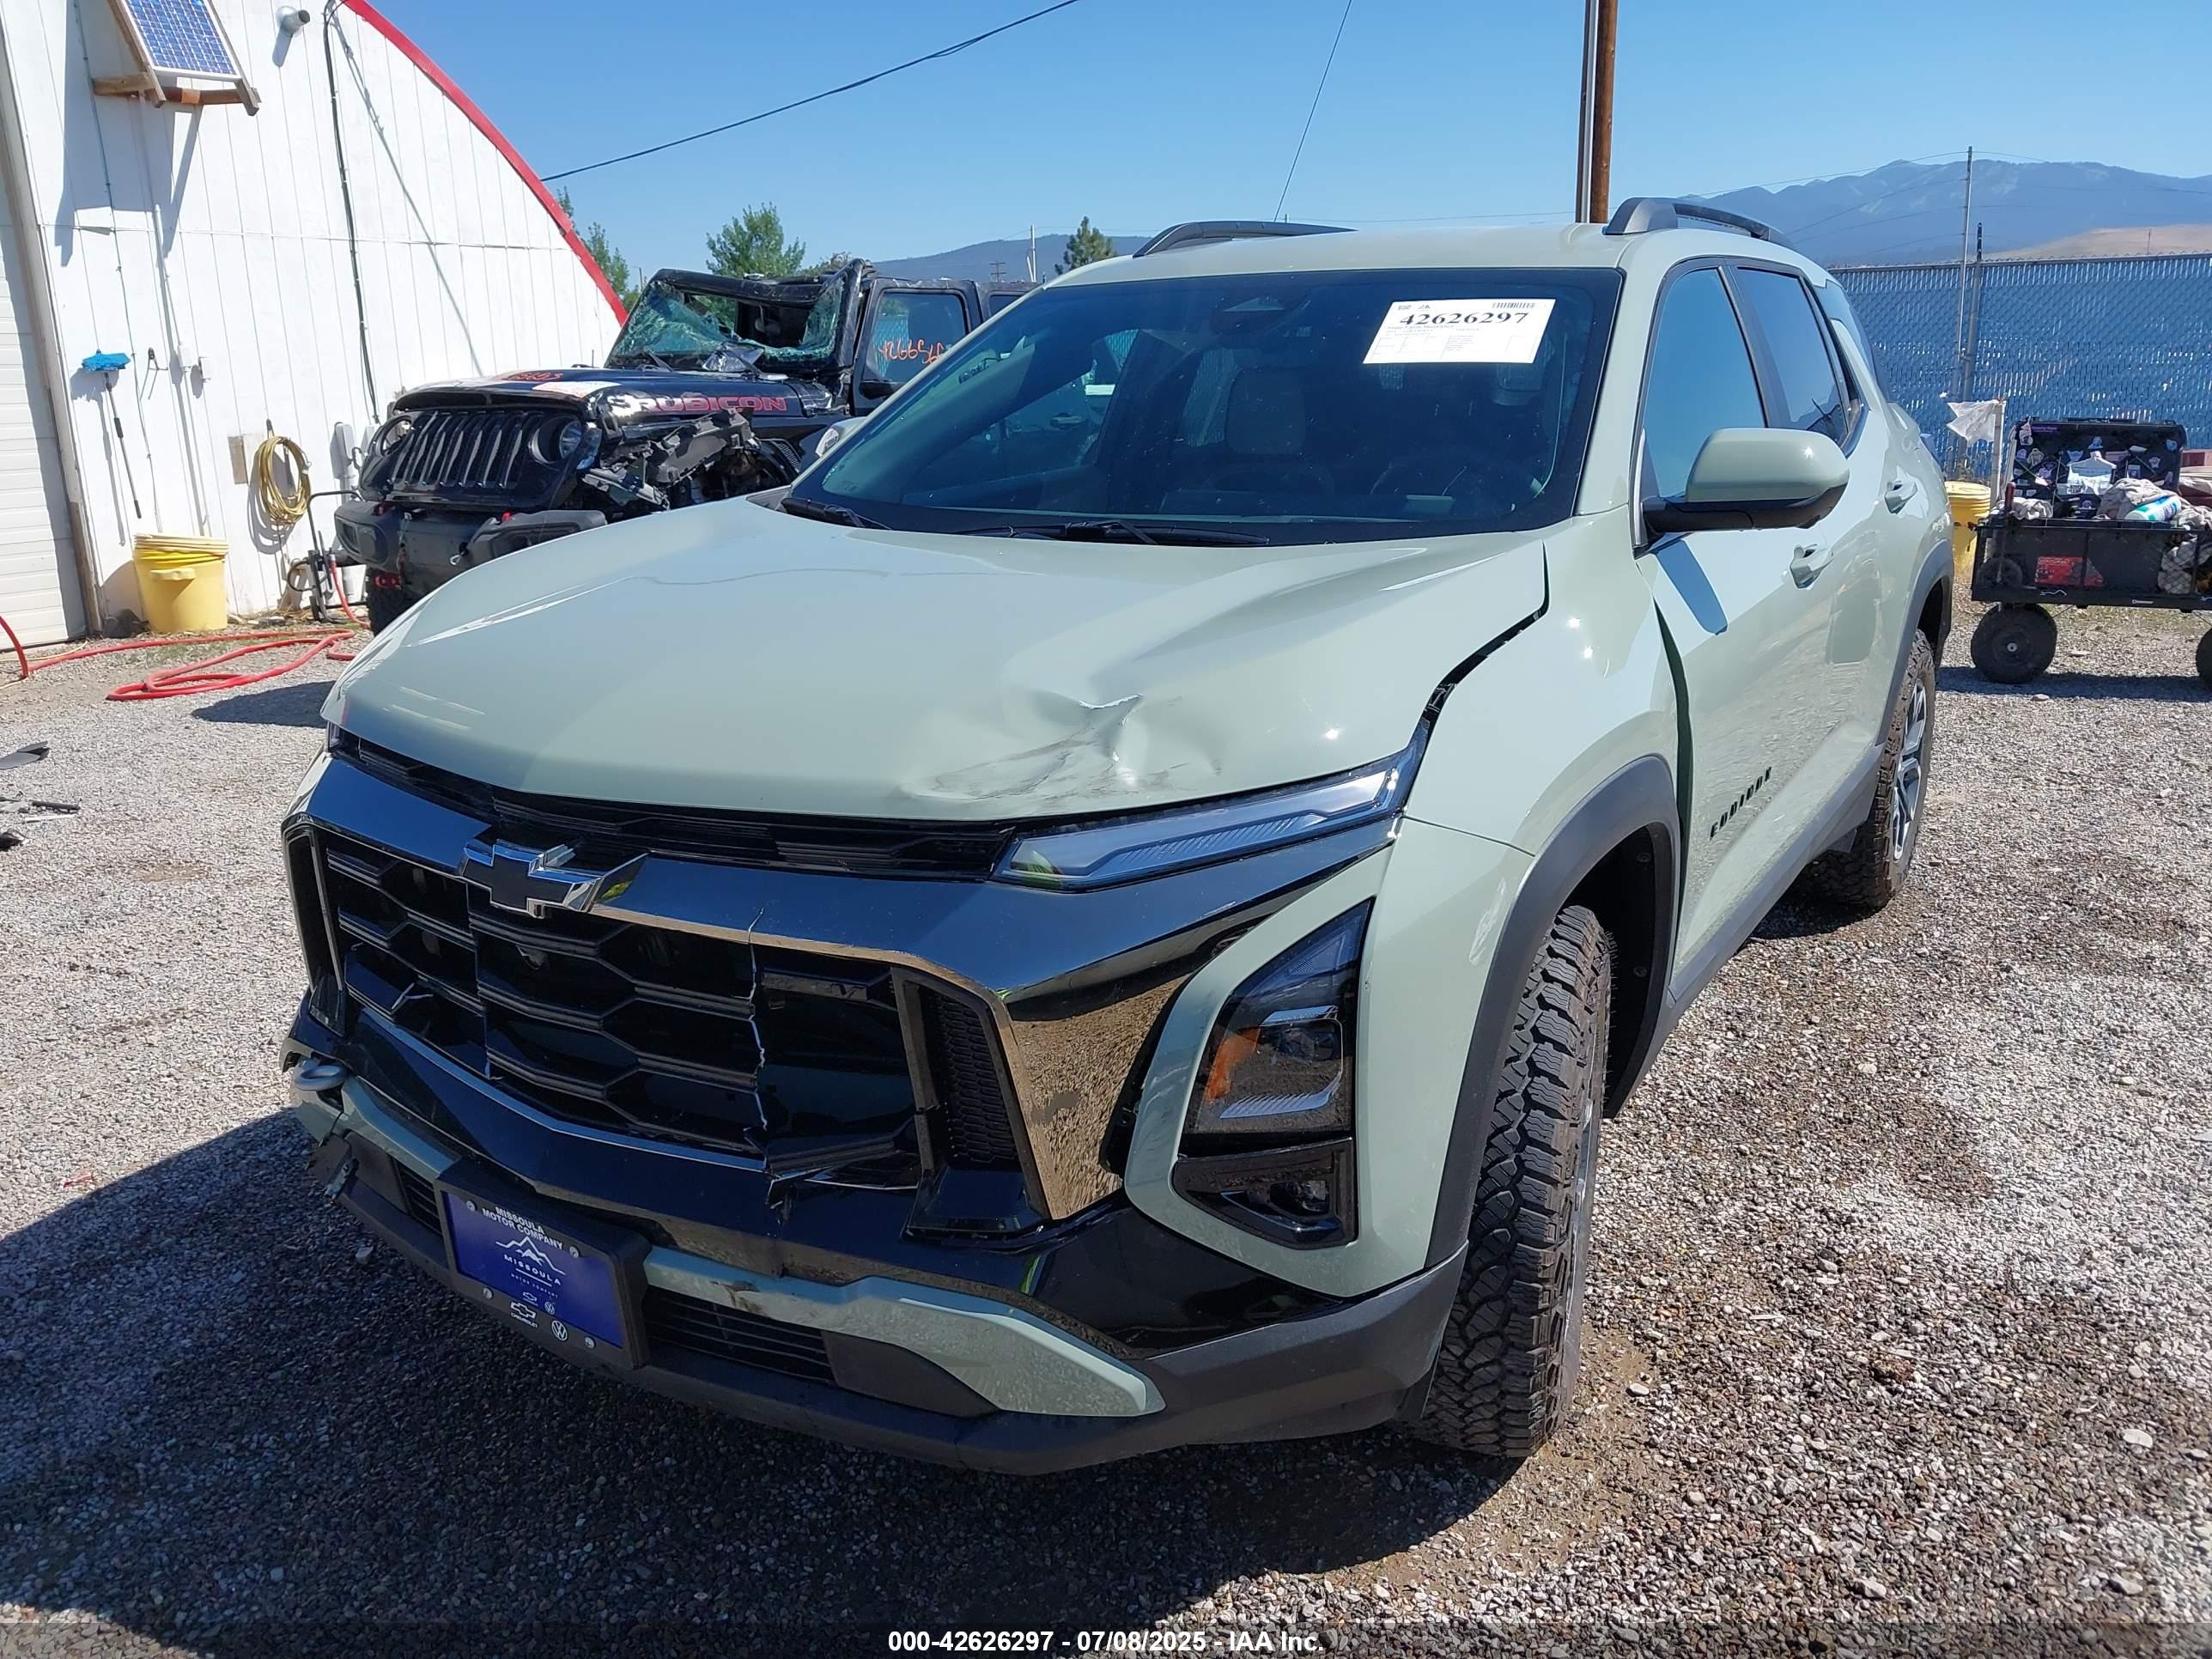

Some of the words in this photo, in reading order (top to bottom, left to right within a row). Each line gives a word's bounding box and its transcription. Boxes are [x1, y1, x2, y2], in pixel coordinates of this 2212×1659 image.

[1400, 312, 1529, 325] 42626297
[640, 396, 787, 412] RUBICON
[482, 1207, 516, 1230] MOTOR
[516, 1224, 563, 1250] COMPANY
[495, 1206, 545, 1235] MISSOULA
[503, 1254, 562, 1286] MISSOULA
